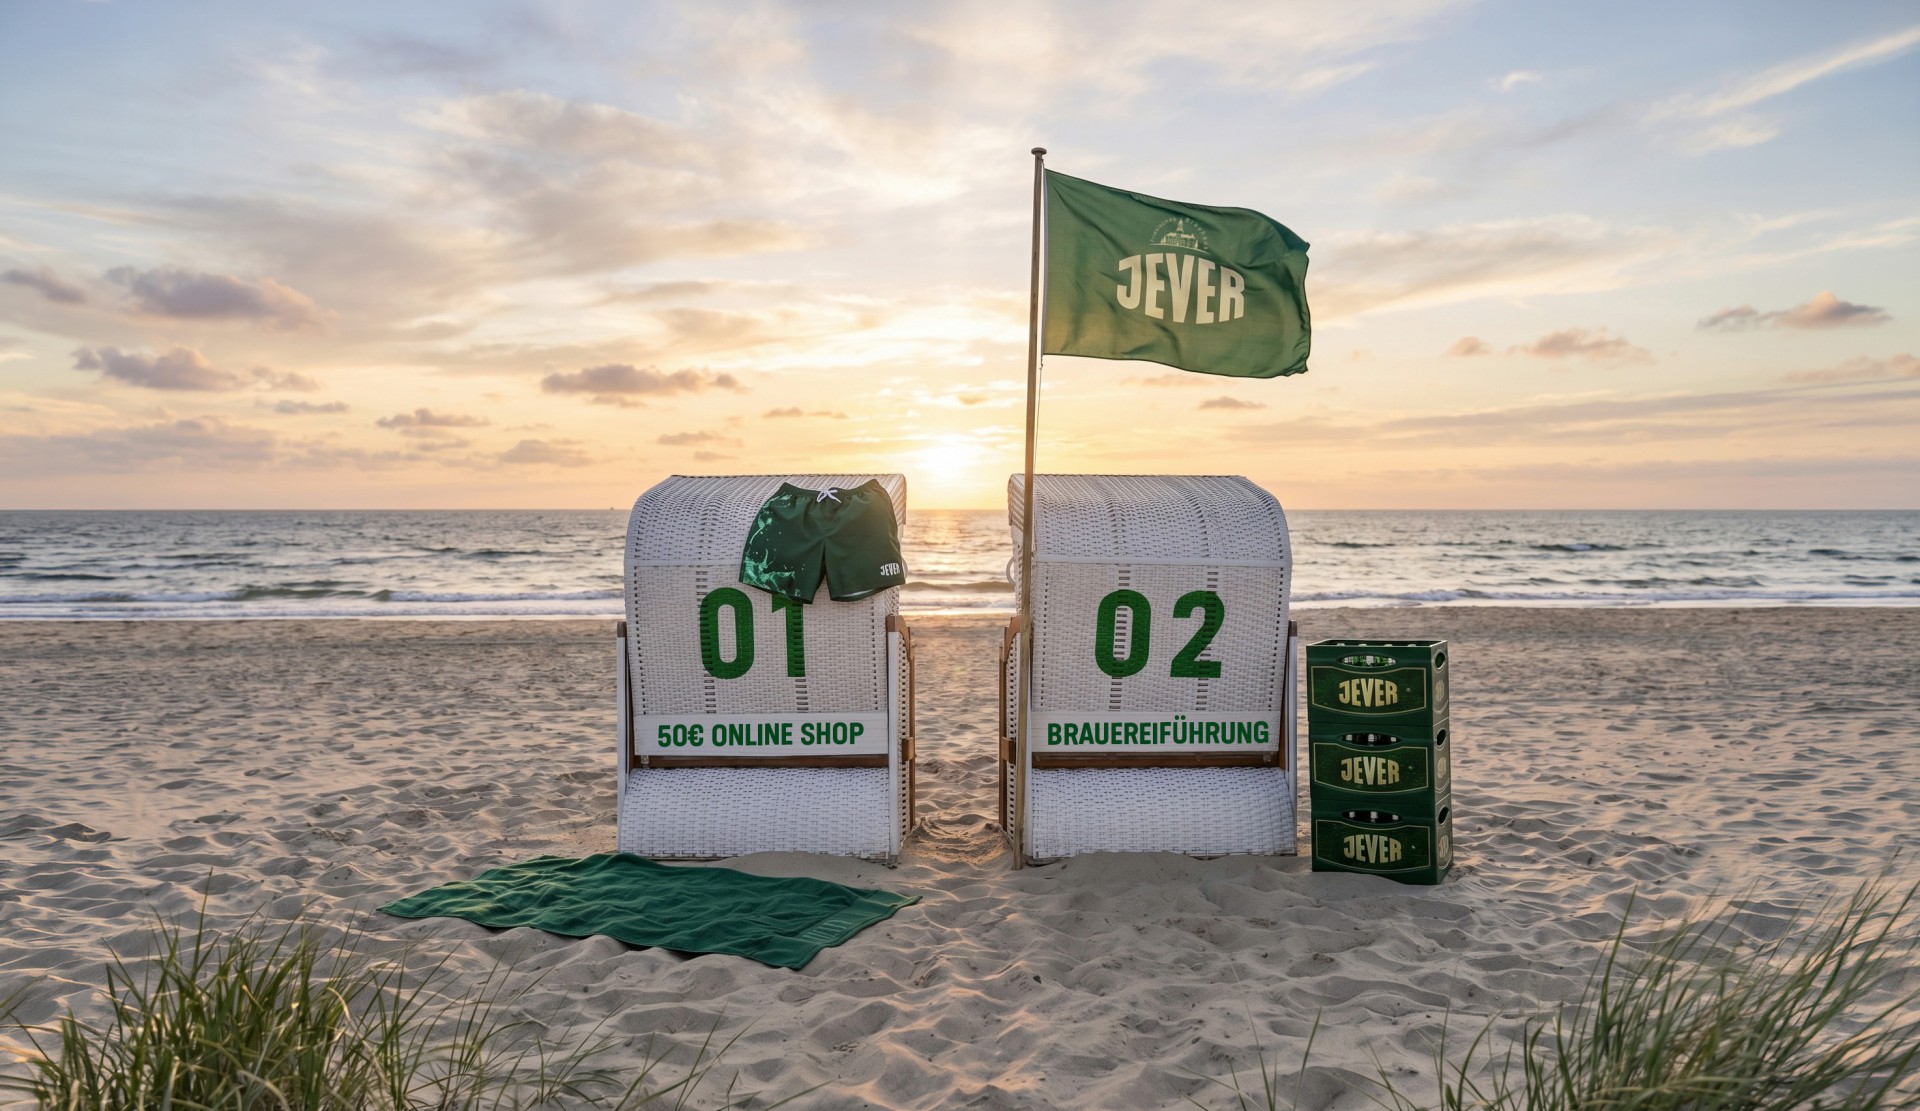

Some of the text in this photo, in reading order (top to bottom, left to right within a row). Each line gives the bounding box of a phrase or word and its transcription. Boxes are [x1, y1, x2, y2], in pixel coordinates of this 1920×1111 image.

[1116, 252, 1245, 325] JEVER
[699, 586, 806, 680] 01
[1094, 588, 1225, 679] 02
[1338, 677, 1399, 708] JEVER
[657, 721, 865, 747] 50€ ONLINE SHOP
[1047, 714, 1269, 746] BRAUEREIFÜHRUNG
[1340, 756, 1400, 786] JEVER
[1343, 833, 1402, 864] JEVER
